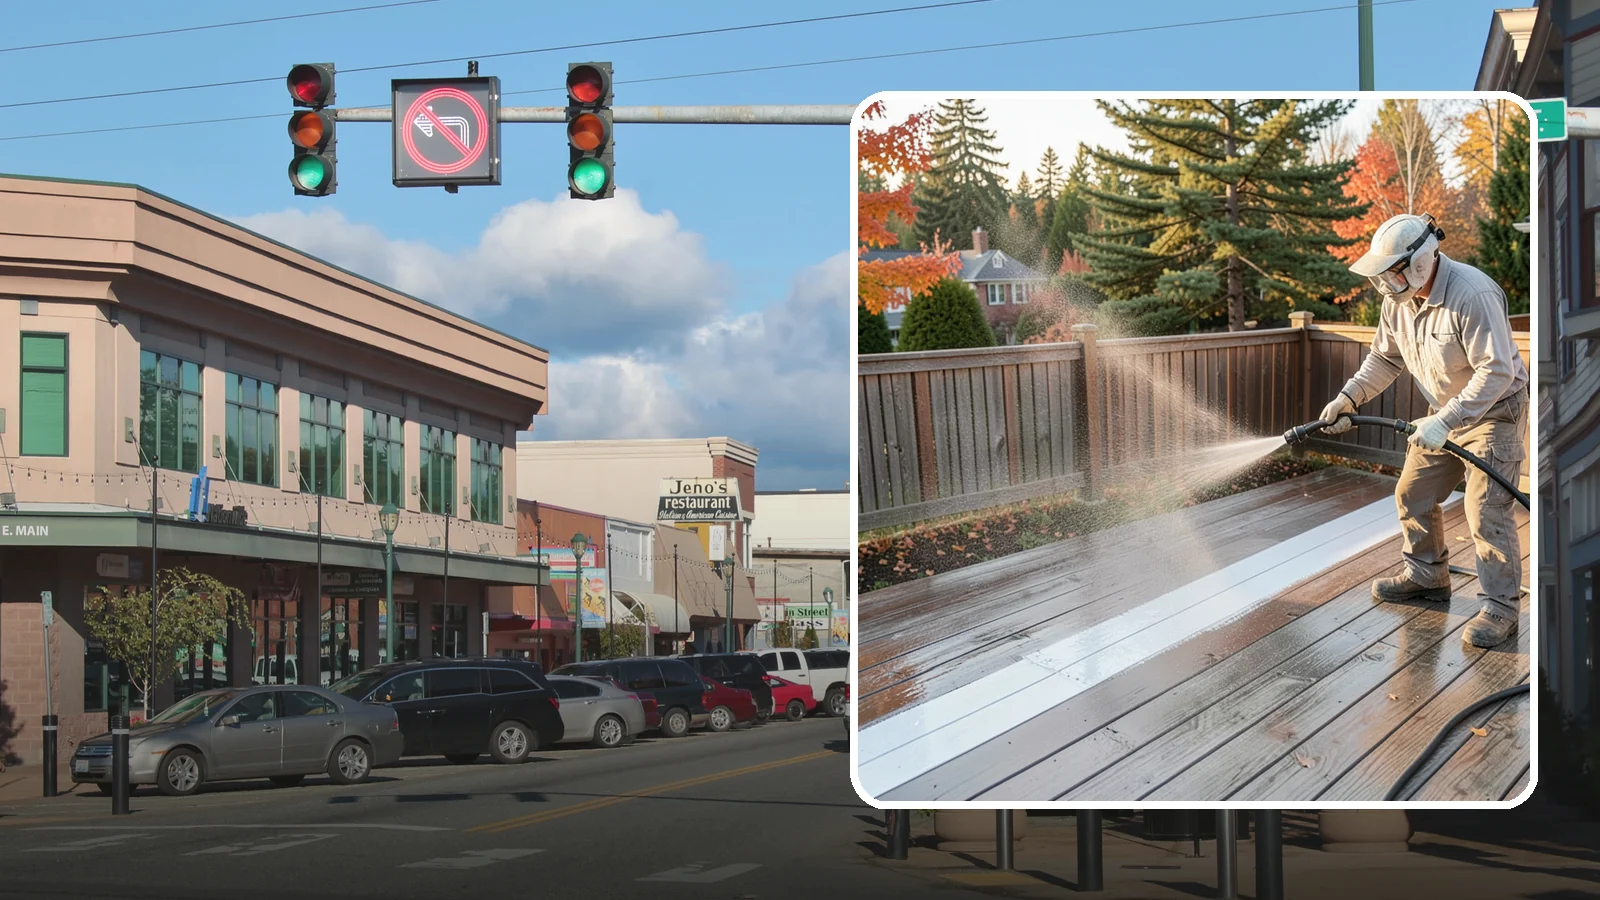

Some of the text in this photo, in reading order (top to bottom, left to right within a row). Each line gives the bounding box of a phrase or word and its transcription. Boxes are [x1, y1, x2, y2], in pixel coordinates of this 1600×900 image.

[670, 480, 727, 494] Jeno's
[665, 496, 731, 509] restaurant
[659, 510, 682, 519] Italian
[686, 510, 715, 519] American
[715, 509, 737, 519] Cuisine
[2, 525, 49, 536] E. MAIN
[797, 607, 828, 617] Street
